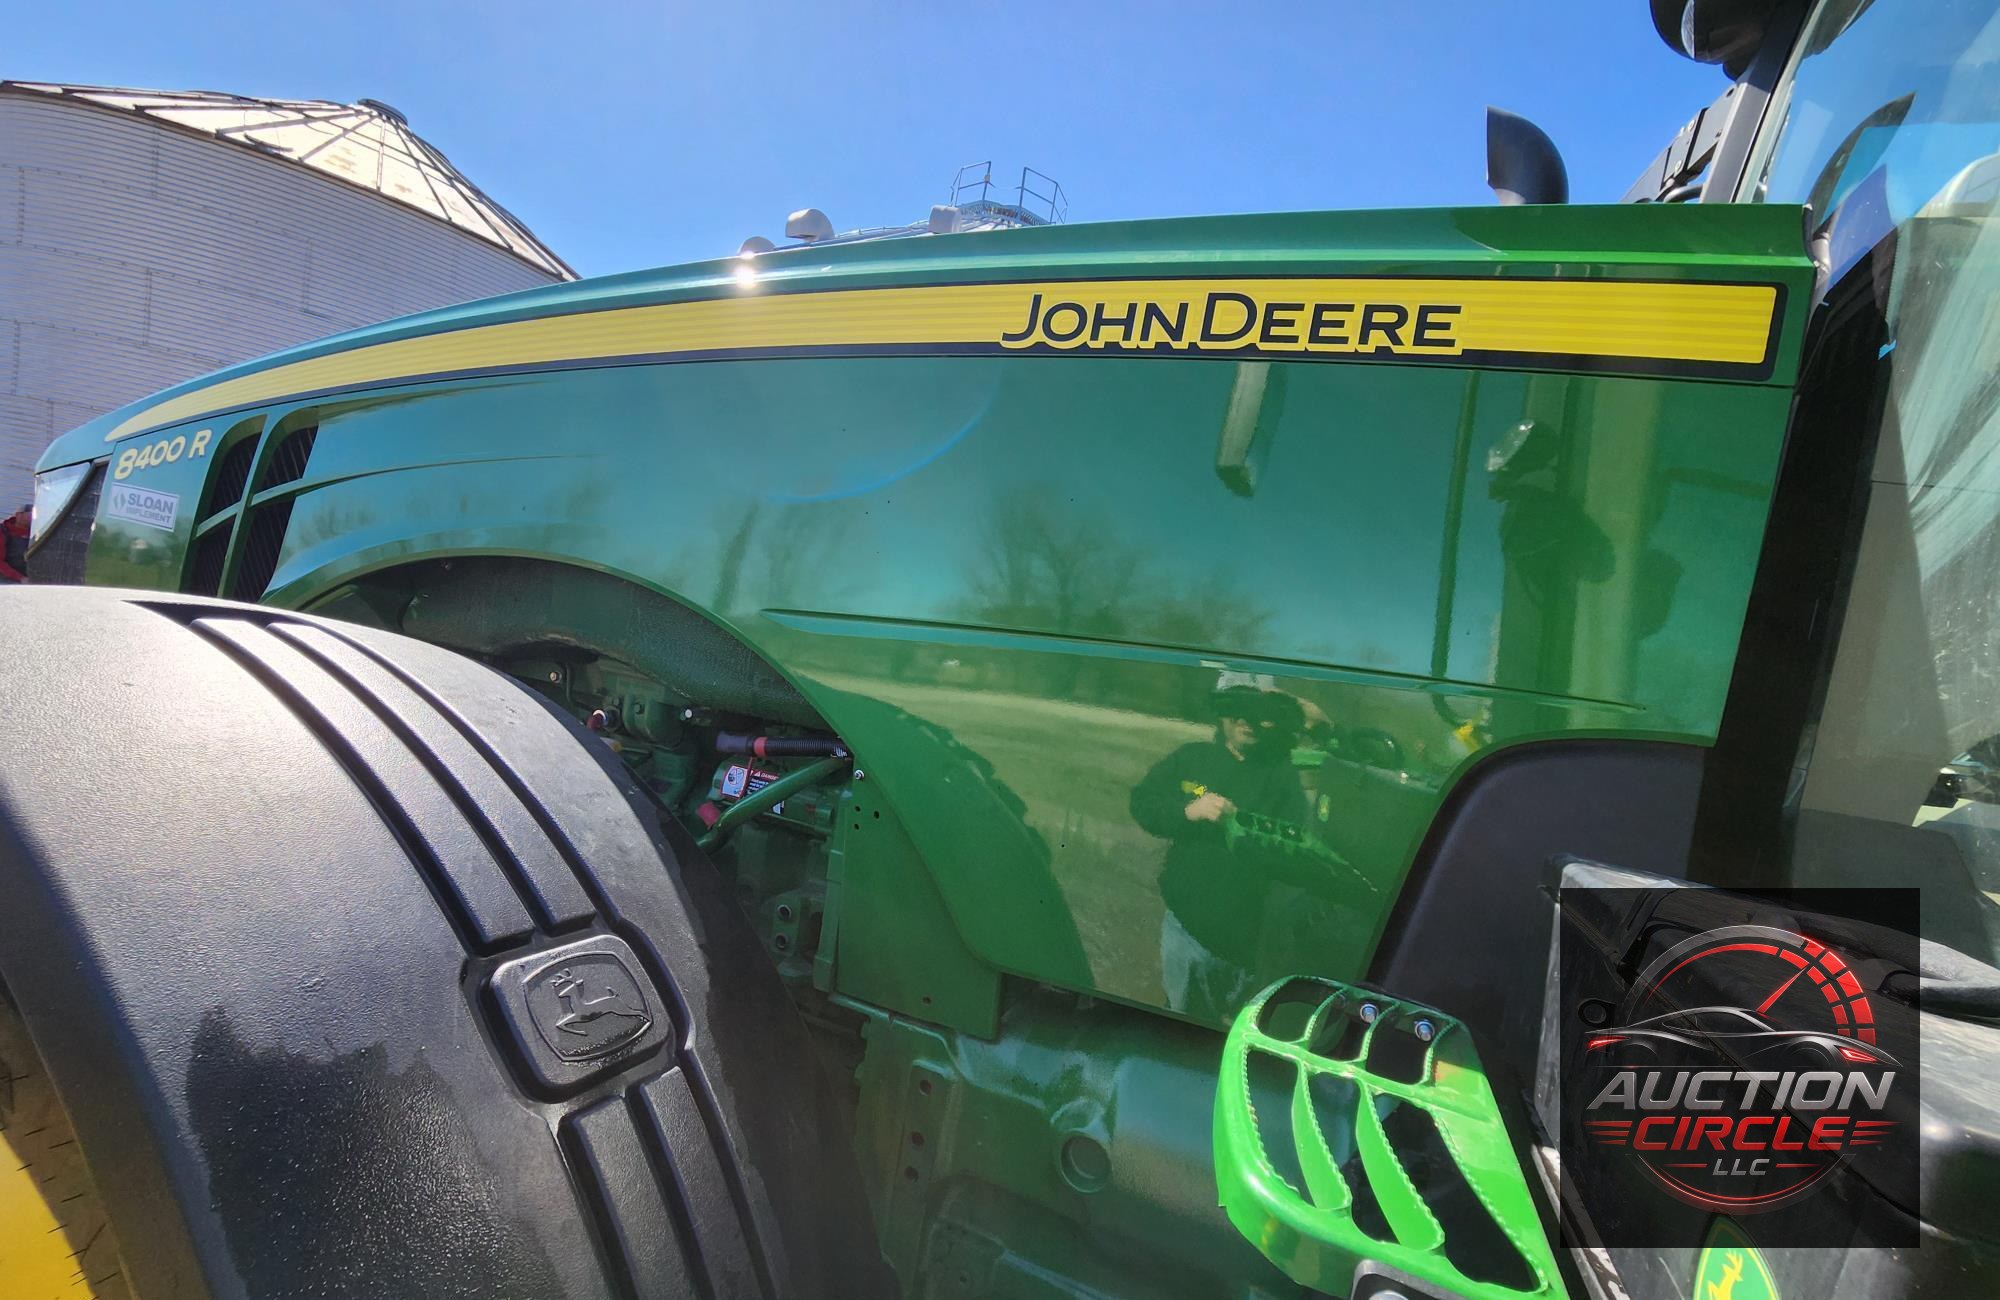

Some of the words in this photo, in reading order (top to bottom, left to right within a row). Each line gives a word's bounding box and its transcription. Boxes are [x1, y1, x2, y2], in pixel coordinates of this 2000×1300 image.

[1001, 293, 1189, 343] JOHN
[1200, 292, 1463, 349] DEERE
[114, 435, 186, 480] 8400
[188, 429, 212, 458] R
[126, 506, 172, 524] IMPLEMENT
[127, 493, 174, 515] SLOAN
